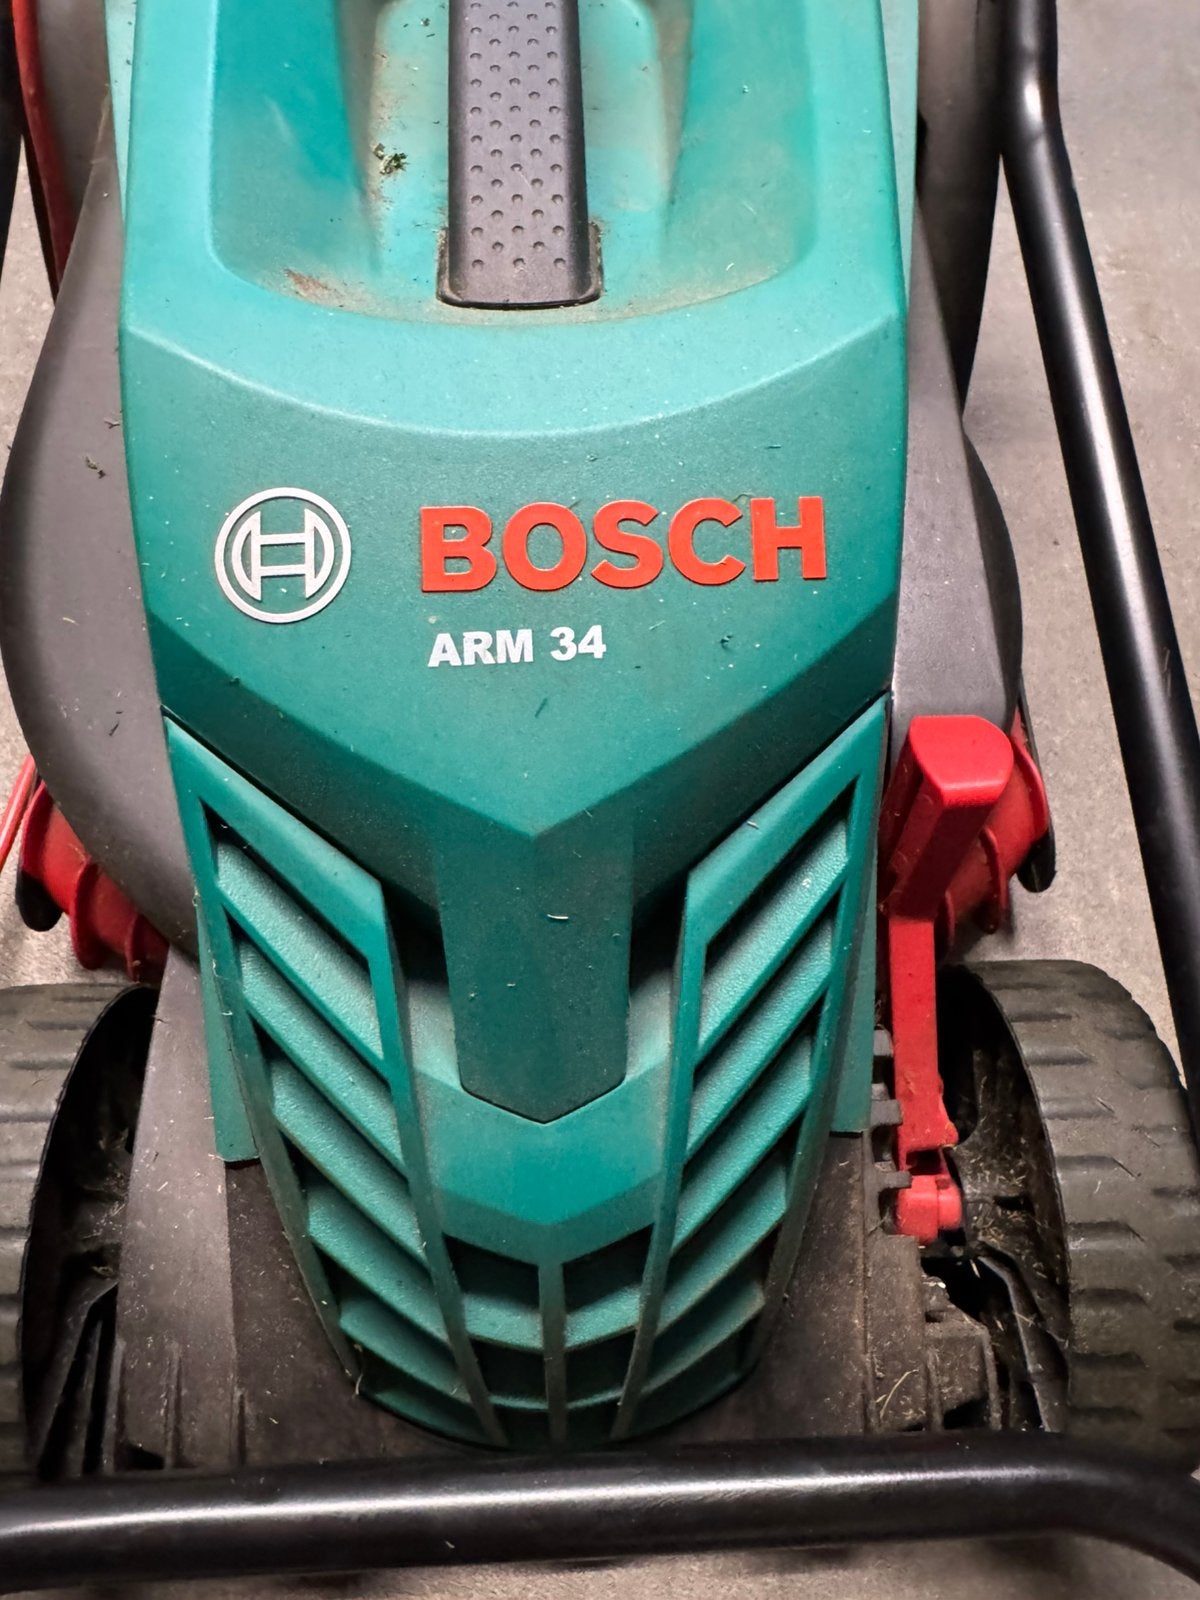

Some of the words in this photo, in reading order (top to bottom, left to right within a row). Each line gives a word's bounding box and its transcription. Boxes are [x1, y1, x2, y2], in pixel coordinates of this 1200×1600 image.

[420, 496, 826, 592] BOSCH
[428, 628, 533, 668] ARM
[550, 625, 606, 662] 34
